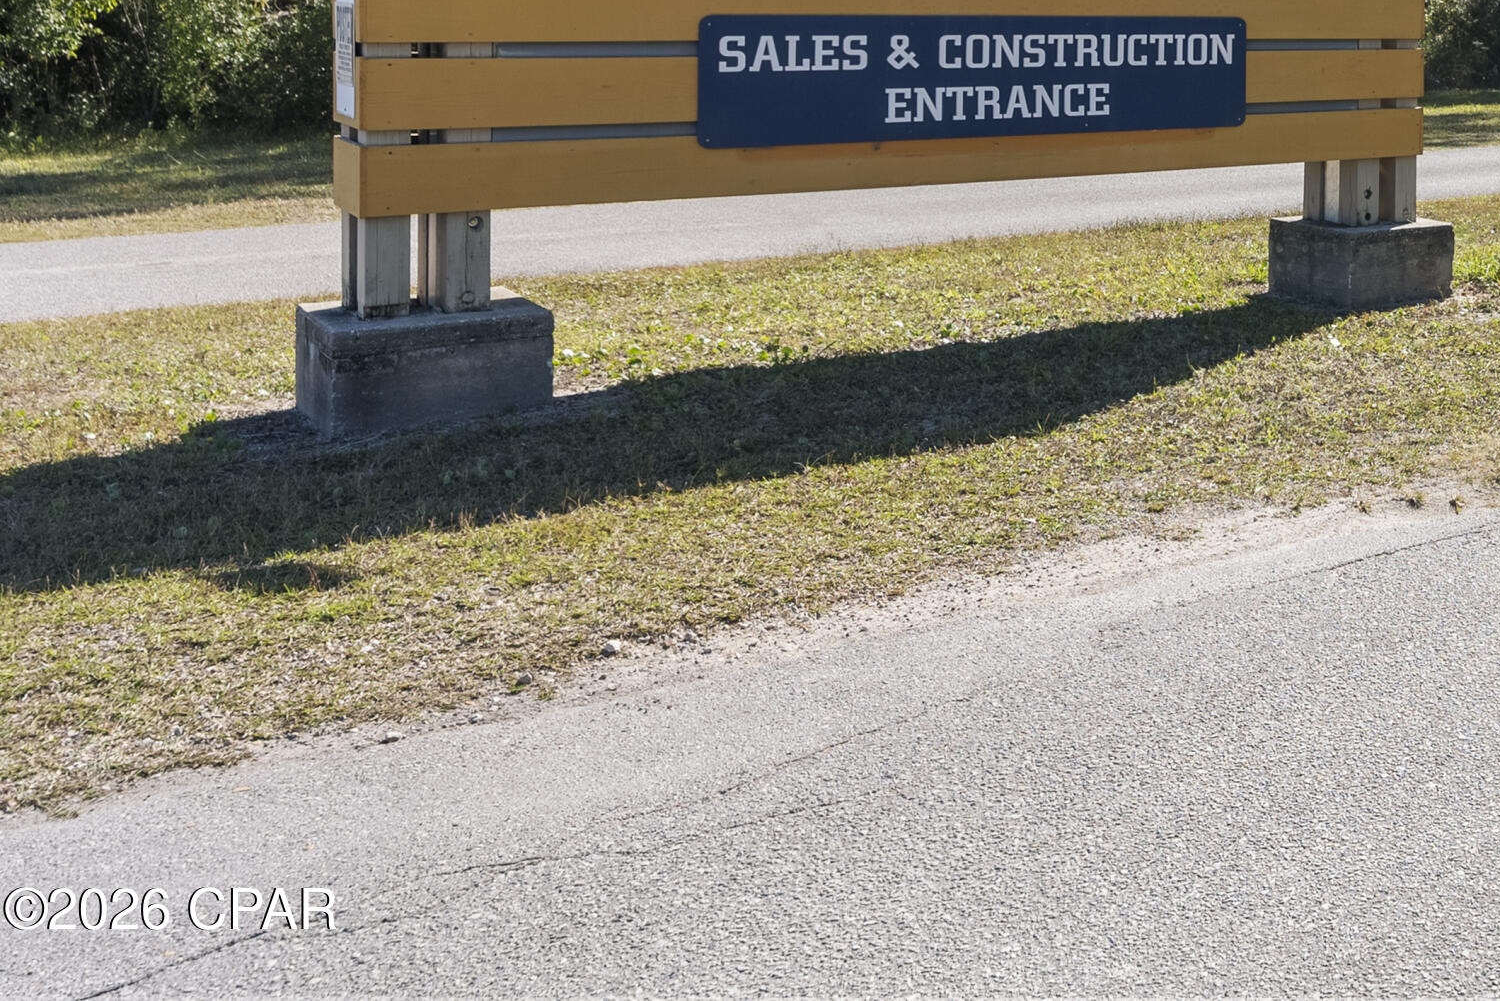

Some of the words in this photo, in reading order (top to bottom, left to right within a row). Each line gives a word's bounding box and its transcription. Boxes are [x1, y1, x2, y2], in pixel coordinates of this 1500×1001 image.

[717, 34, 869, 73] SALES
[884, 35, 919, 70] &
[937, 32, 1235, 71] CONSTRUCTION
[884, 83, 1111, 124] ENTRANCE
